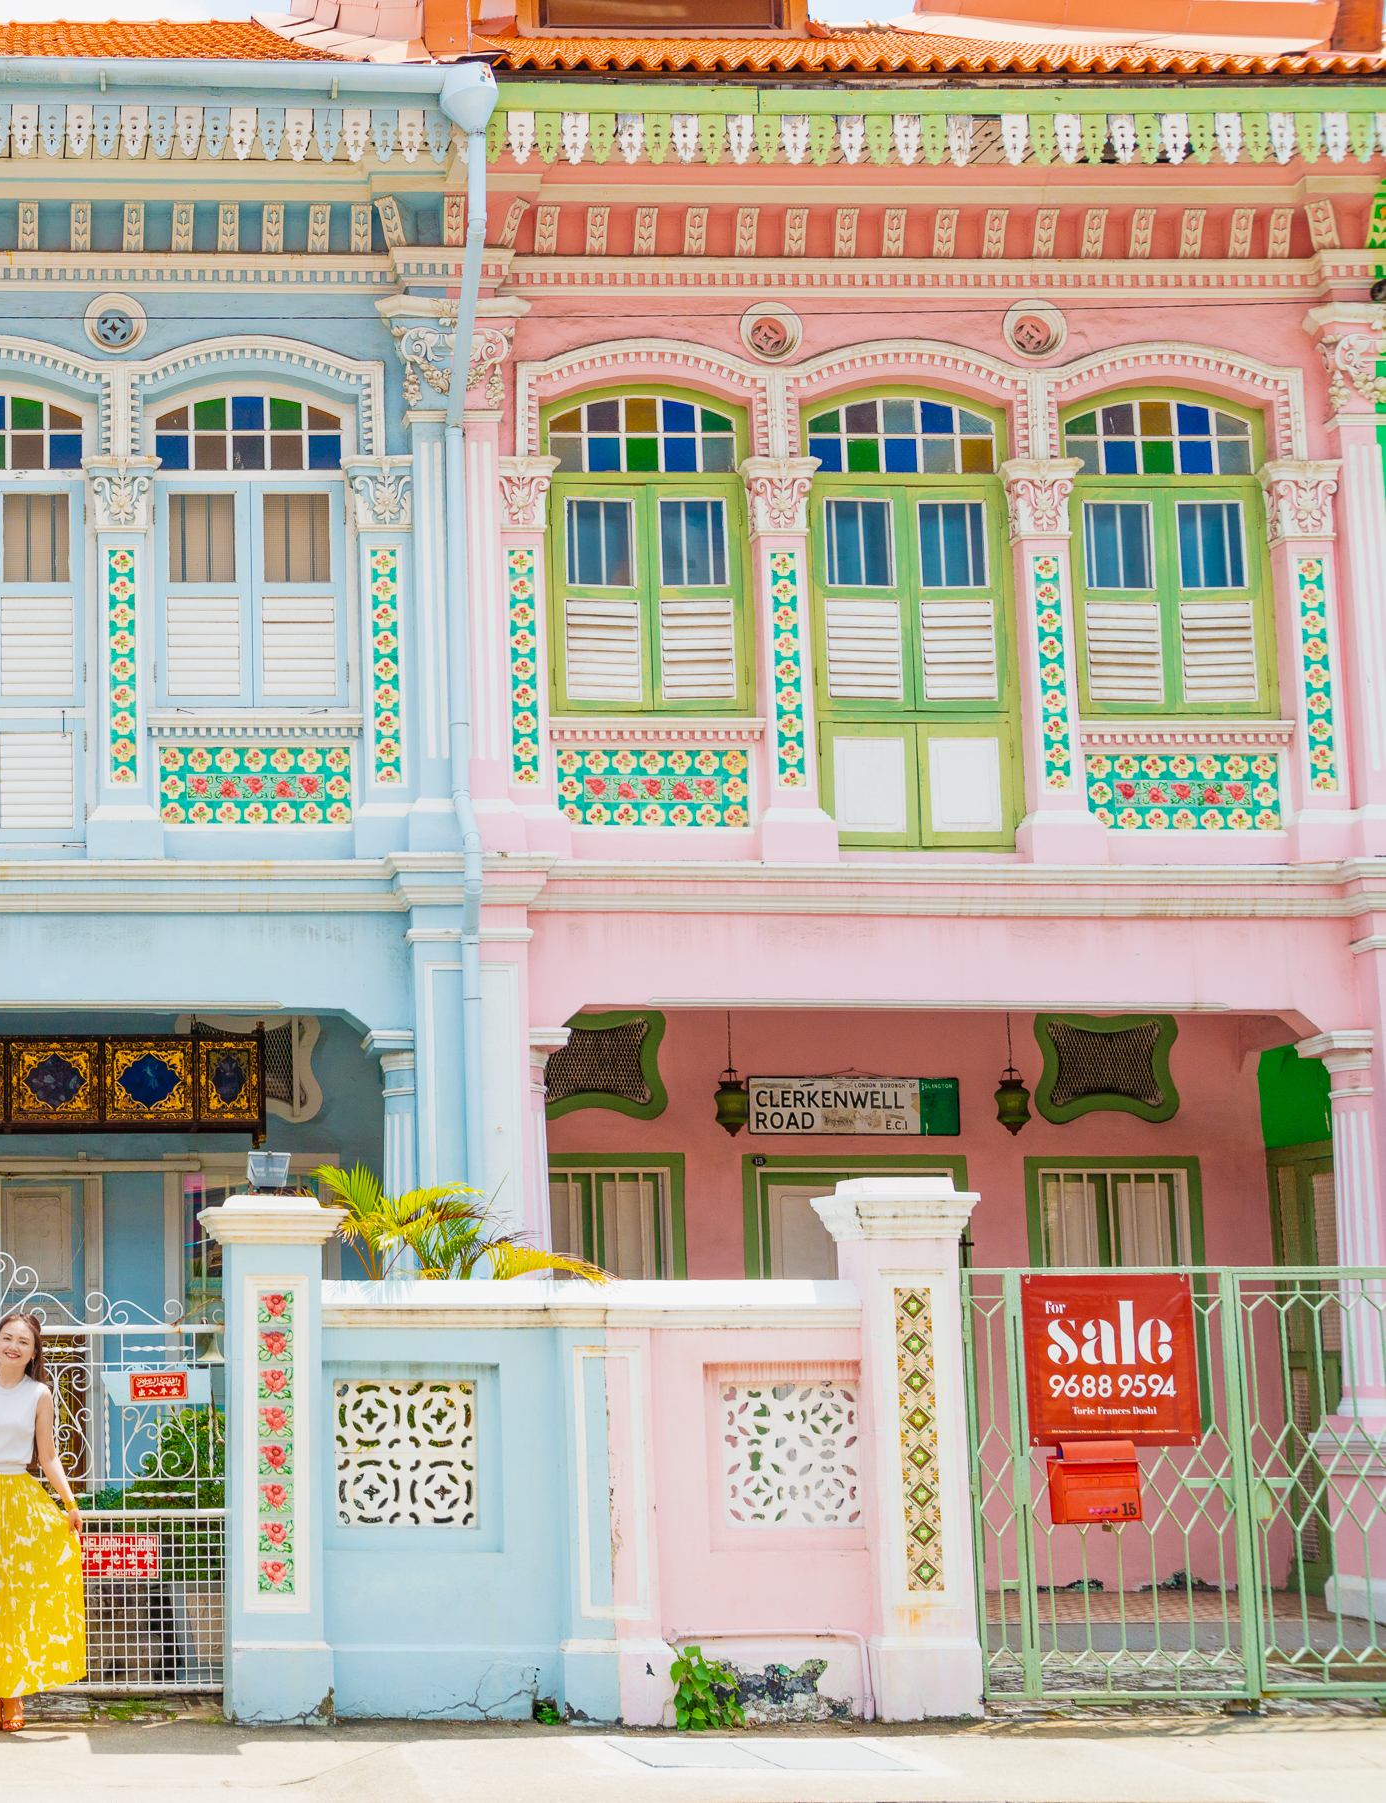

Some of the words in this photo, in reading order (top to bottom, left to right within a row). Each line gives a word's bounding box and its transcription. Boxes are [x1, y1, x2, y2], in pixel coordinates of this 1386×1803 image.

[755, 1090, 905, 1109] CLERKENWELL
[755, 1111, 815, 1130] ROAD
[1044, 1300, 1067, 1314] for
[1047, 1300, 1173, 1365] sale
[1048, 1374, 1113, 1398] 9688
[1117, 1374, 1177, 1398] 9594
[1097, 1406, 1131, 1415] Frances
[1132, 1406, 1158, 1415] Doshi
[1121, 1502, 1137, 1516] 15
